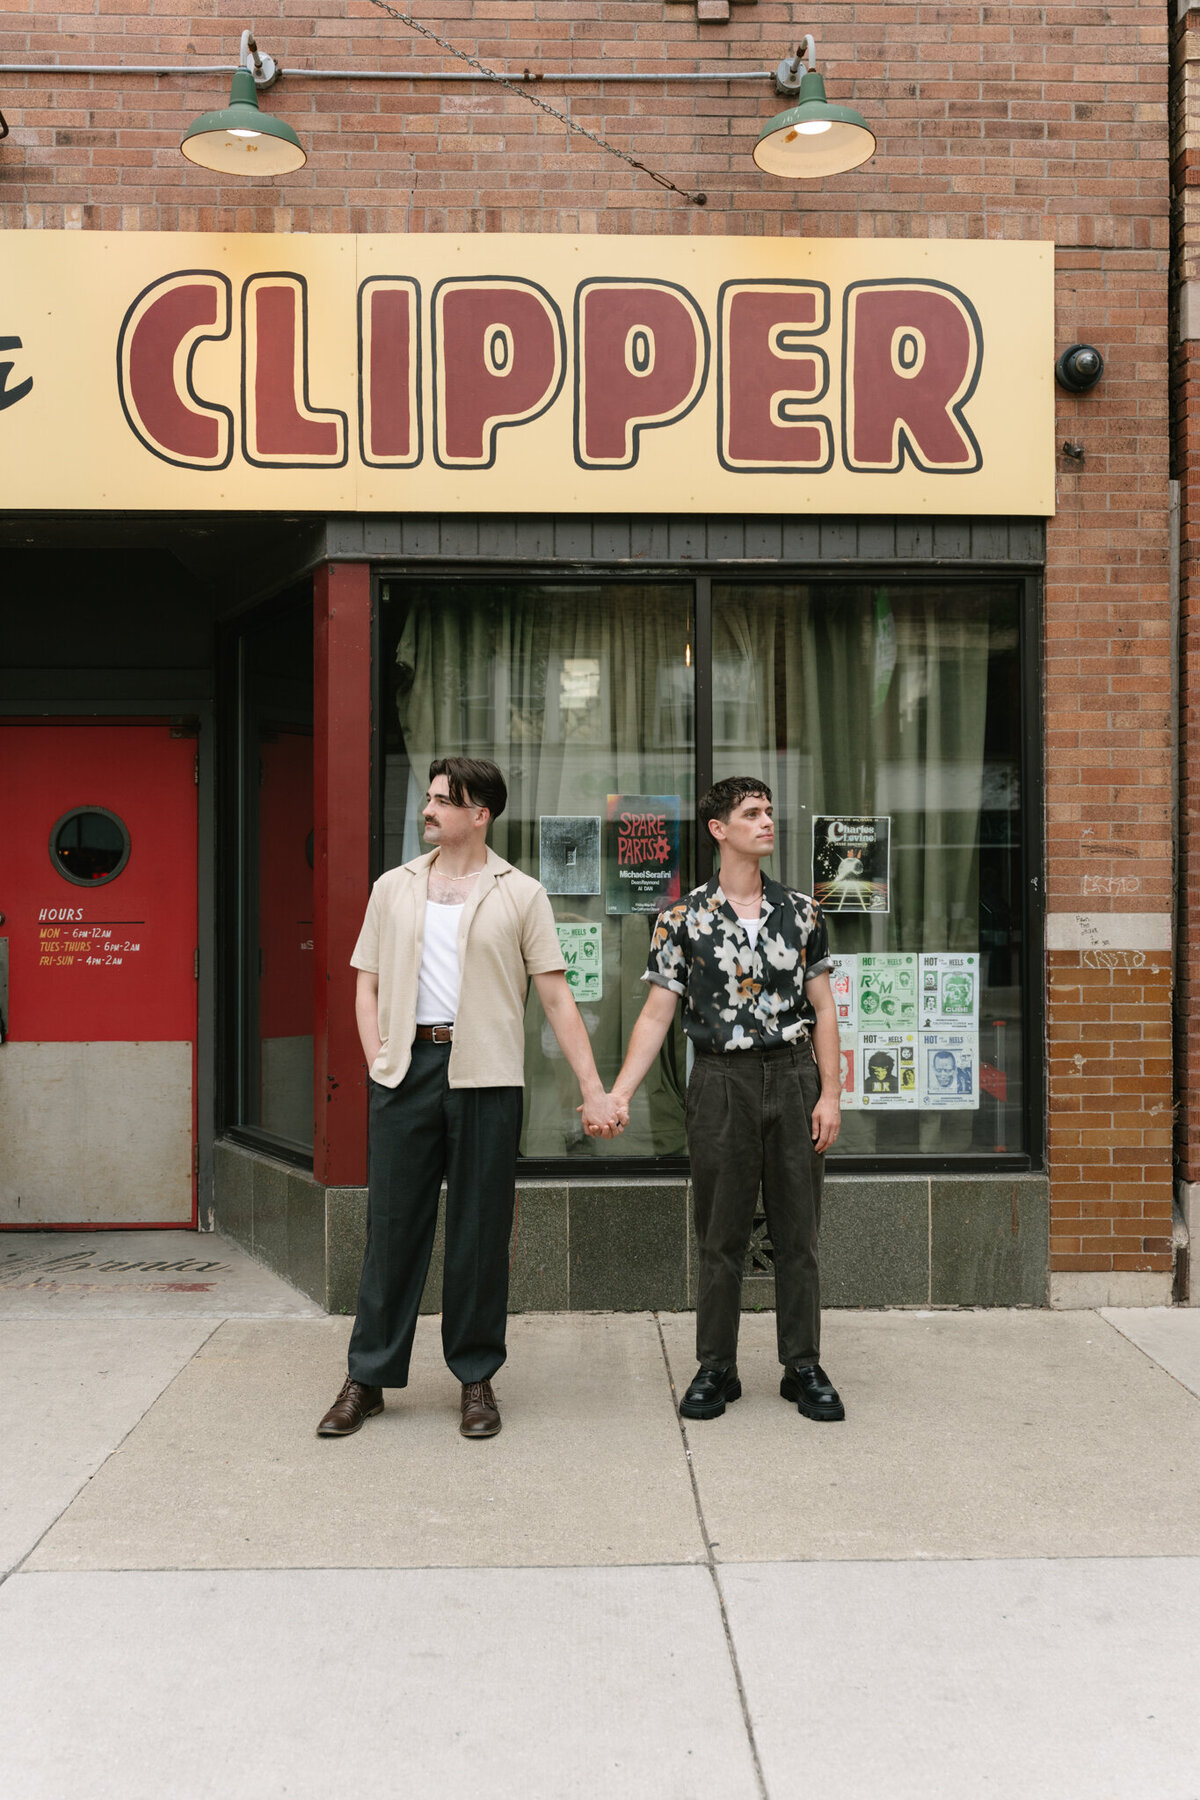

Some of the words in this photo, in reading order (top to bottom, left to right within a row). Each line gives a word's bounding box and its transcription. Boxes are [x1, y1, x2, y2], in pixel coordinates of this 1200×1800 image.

[117, 269, 983, 475] CLIPPER
[618, 811, 667, 837] SPARE
[828, 821, 875, 841] Charles
[618, 836, 655, 865] PARTS
[619, 870, 645, 879] Michael
[645, 870, 672, 879] Serafini
[39, 908, 84, 921] HOURS
[39, 928, 61, 939] MON
[571, 928, 587, 936] HEELS
[40, 941, 92, 952] TUES-THURS
[39, 955, 75, 966] FRI-SUN
[862, 957, 877, 966] HOT
[887, 958, 902, 966] HEELS
[923, 957, 938, 966] HOT
[949, 958, 964, 966] HEELS
[863, 1034, 878, 1043] HOT
[888, 1035, 903, 1043] HEELS
[923, 1035, 939, 1044] HOT
